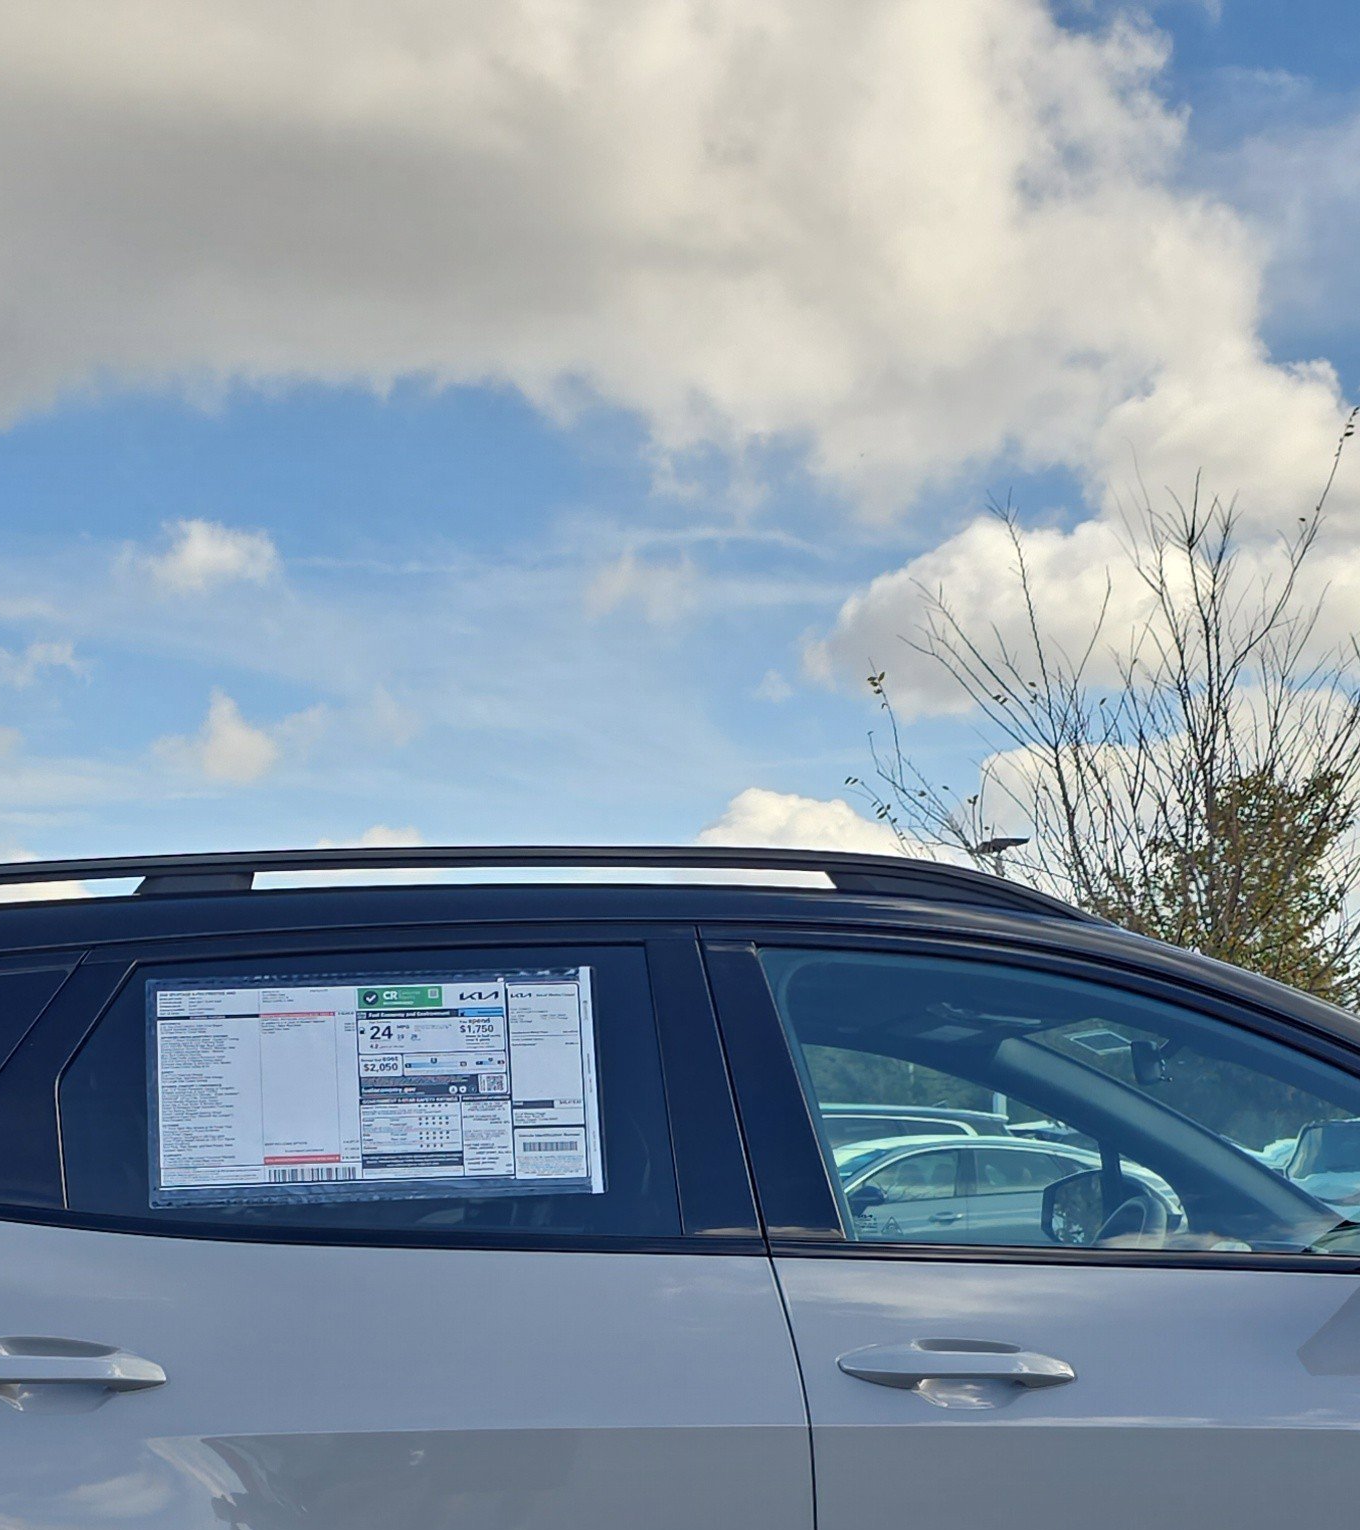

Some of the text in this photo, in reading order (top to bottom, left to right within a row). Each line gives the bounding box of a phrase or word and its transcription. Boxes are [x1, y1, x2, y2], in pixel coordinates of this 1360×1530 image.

[383, 991, 398, 1000] CR
[460, 990, 499, 1001] KIA
[370, 1025, 393, 1040] 24
[460, 1024, 494, 1033] $1,750
[364, 1062, 399, 1072] $2,050
